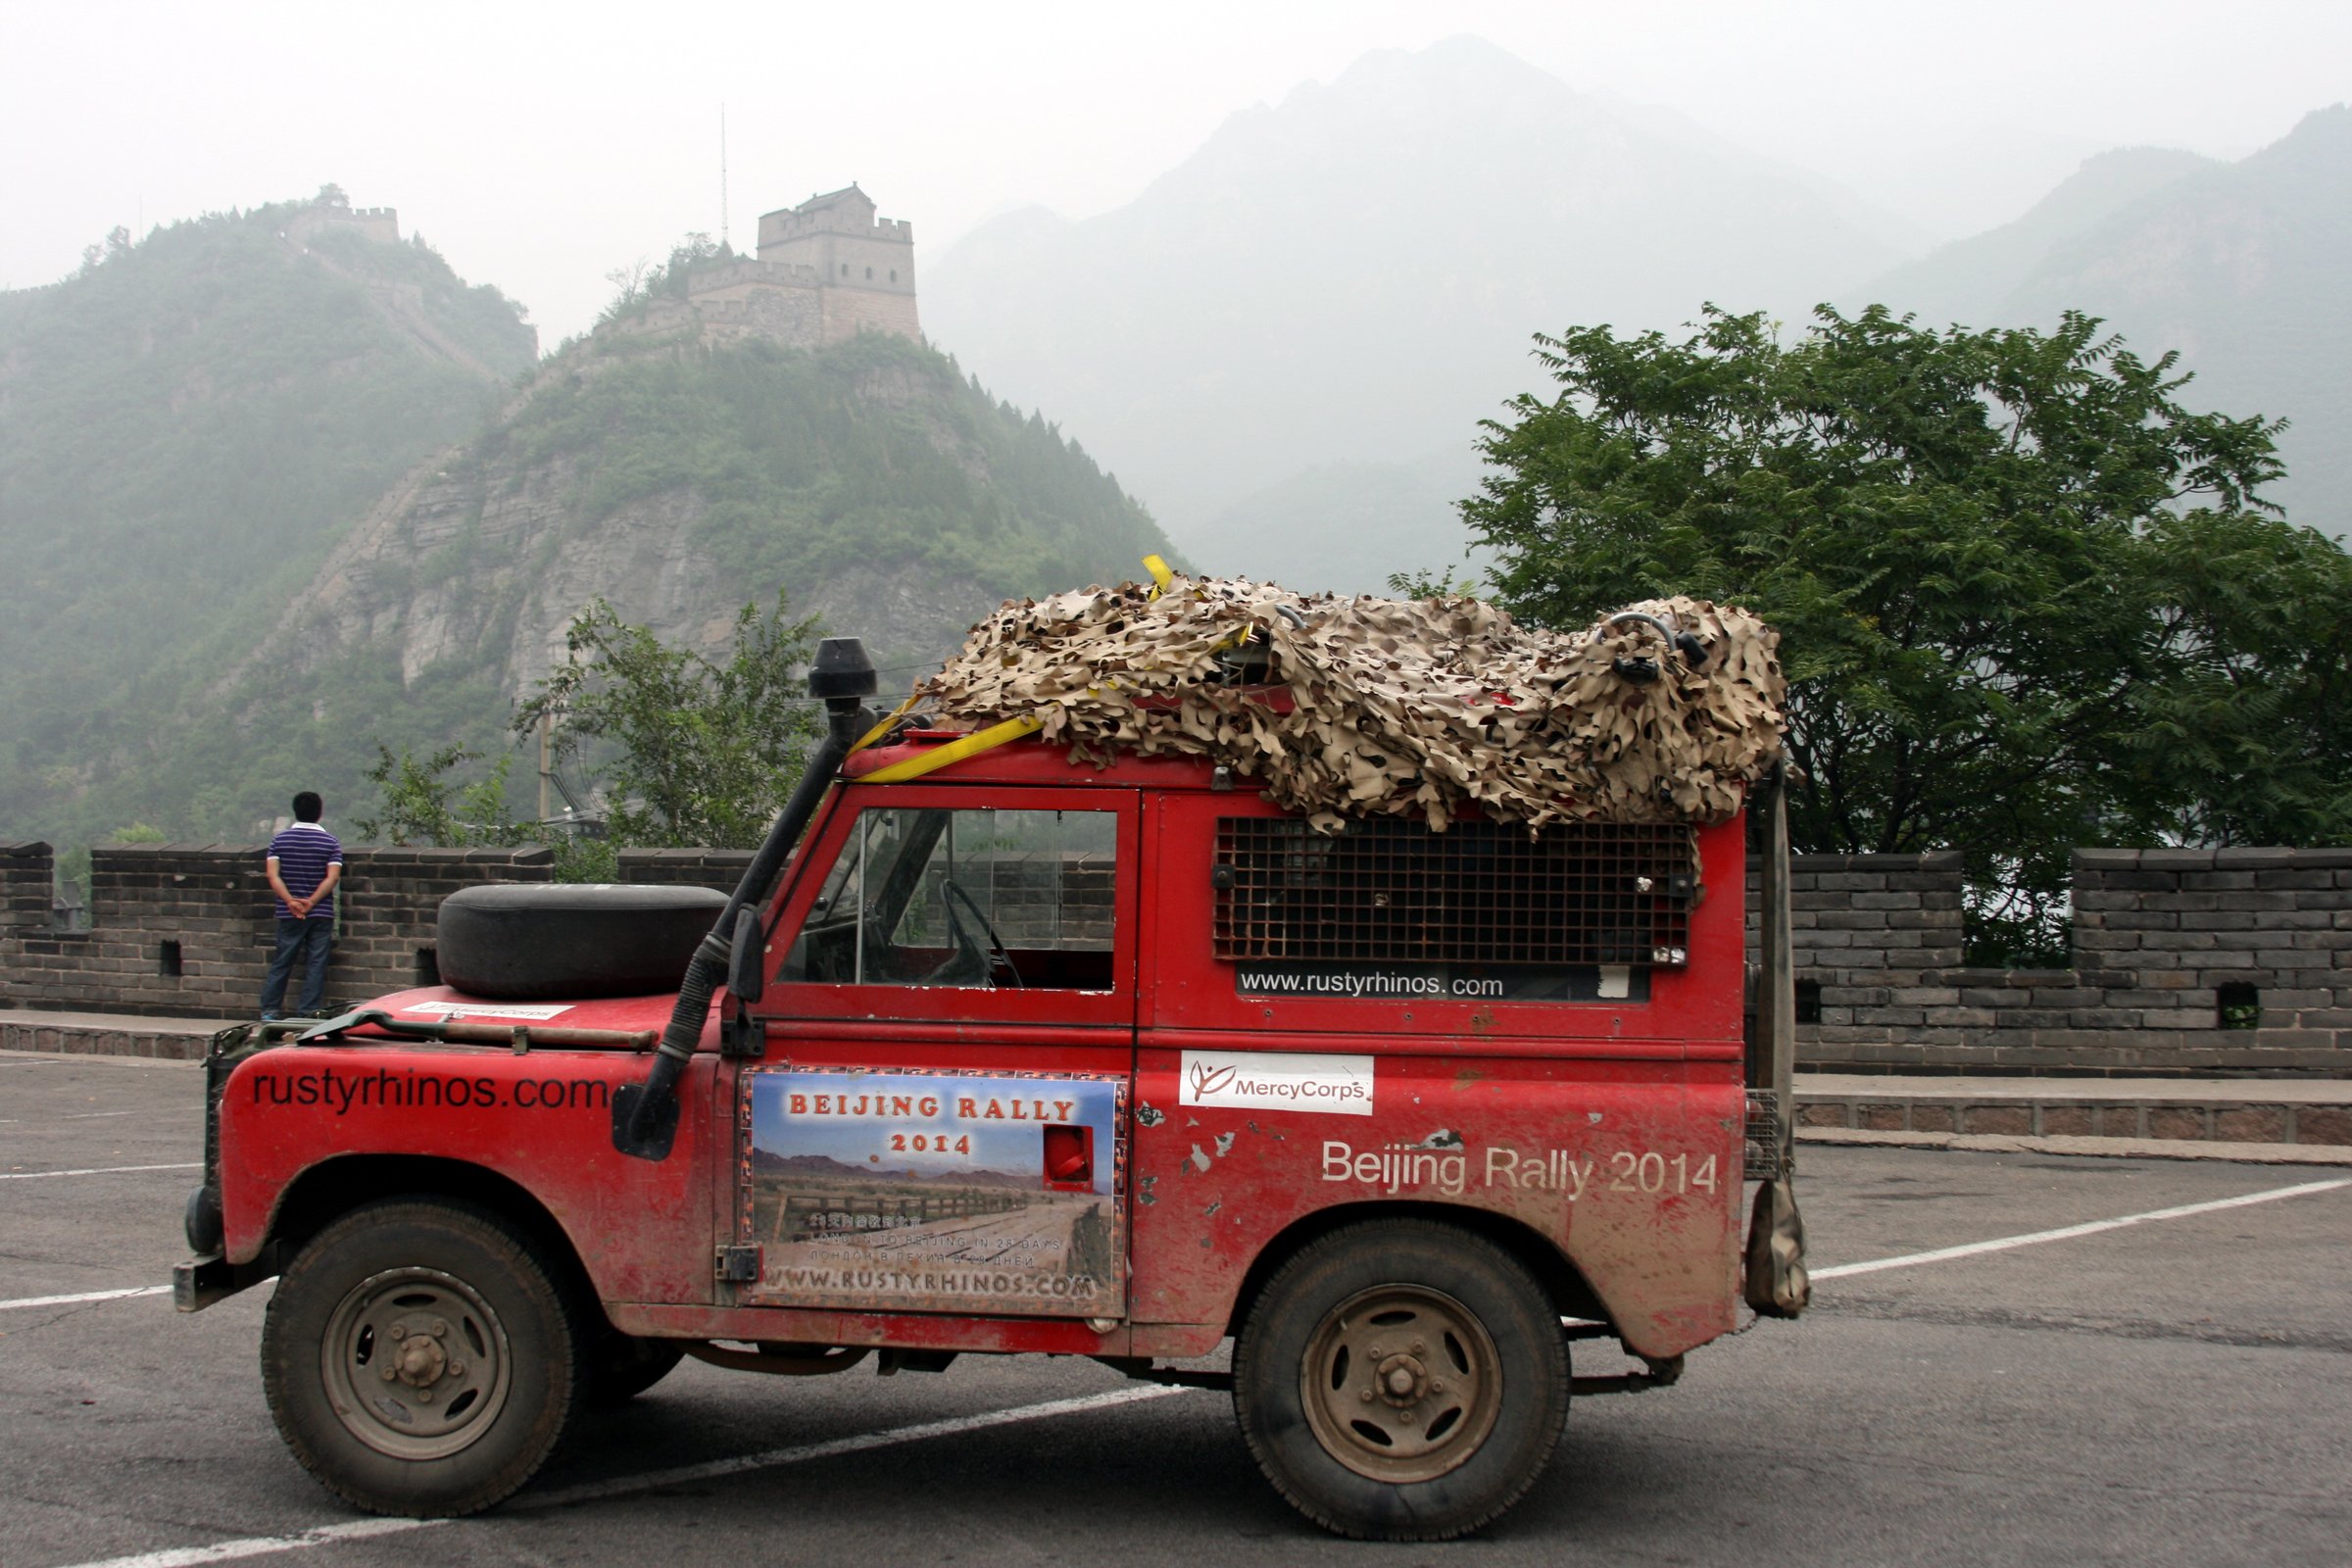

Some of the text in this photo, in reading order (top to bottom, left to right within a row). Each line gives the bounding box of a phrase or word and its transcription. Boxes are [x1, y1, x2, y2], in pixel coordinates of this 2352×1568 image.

[254, 1068, 609, 1115] rustyrhinos.com
[1235, 1080, 1365, 1101] MercyCorps
[790, 1094, 1074, 1121] BEIJING RALLY
[891, 1134, 970, 1154] 2014
[1322, 1141, 1717, 1200] Beijing Rally 2014
[810, 1232, 1060, 1250] LONDON TO BEIJING IN 28 DAYS
[969, 1254, 986, 1265] 28
[993, 1254, 1035, 1267] ДНЕЙ
[763, 1270, 1093, 1297] WWW.RUSTYRHINOS.COM
